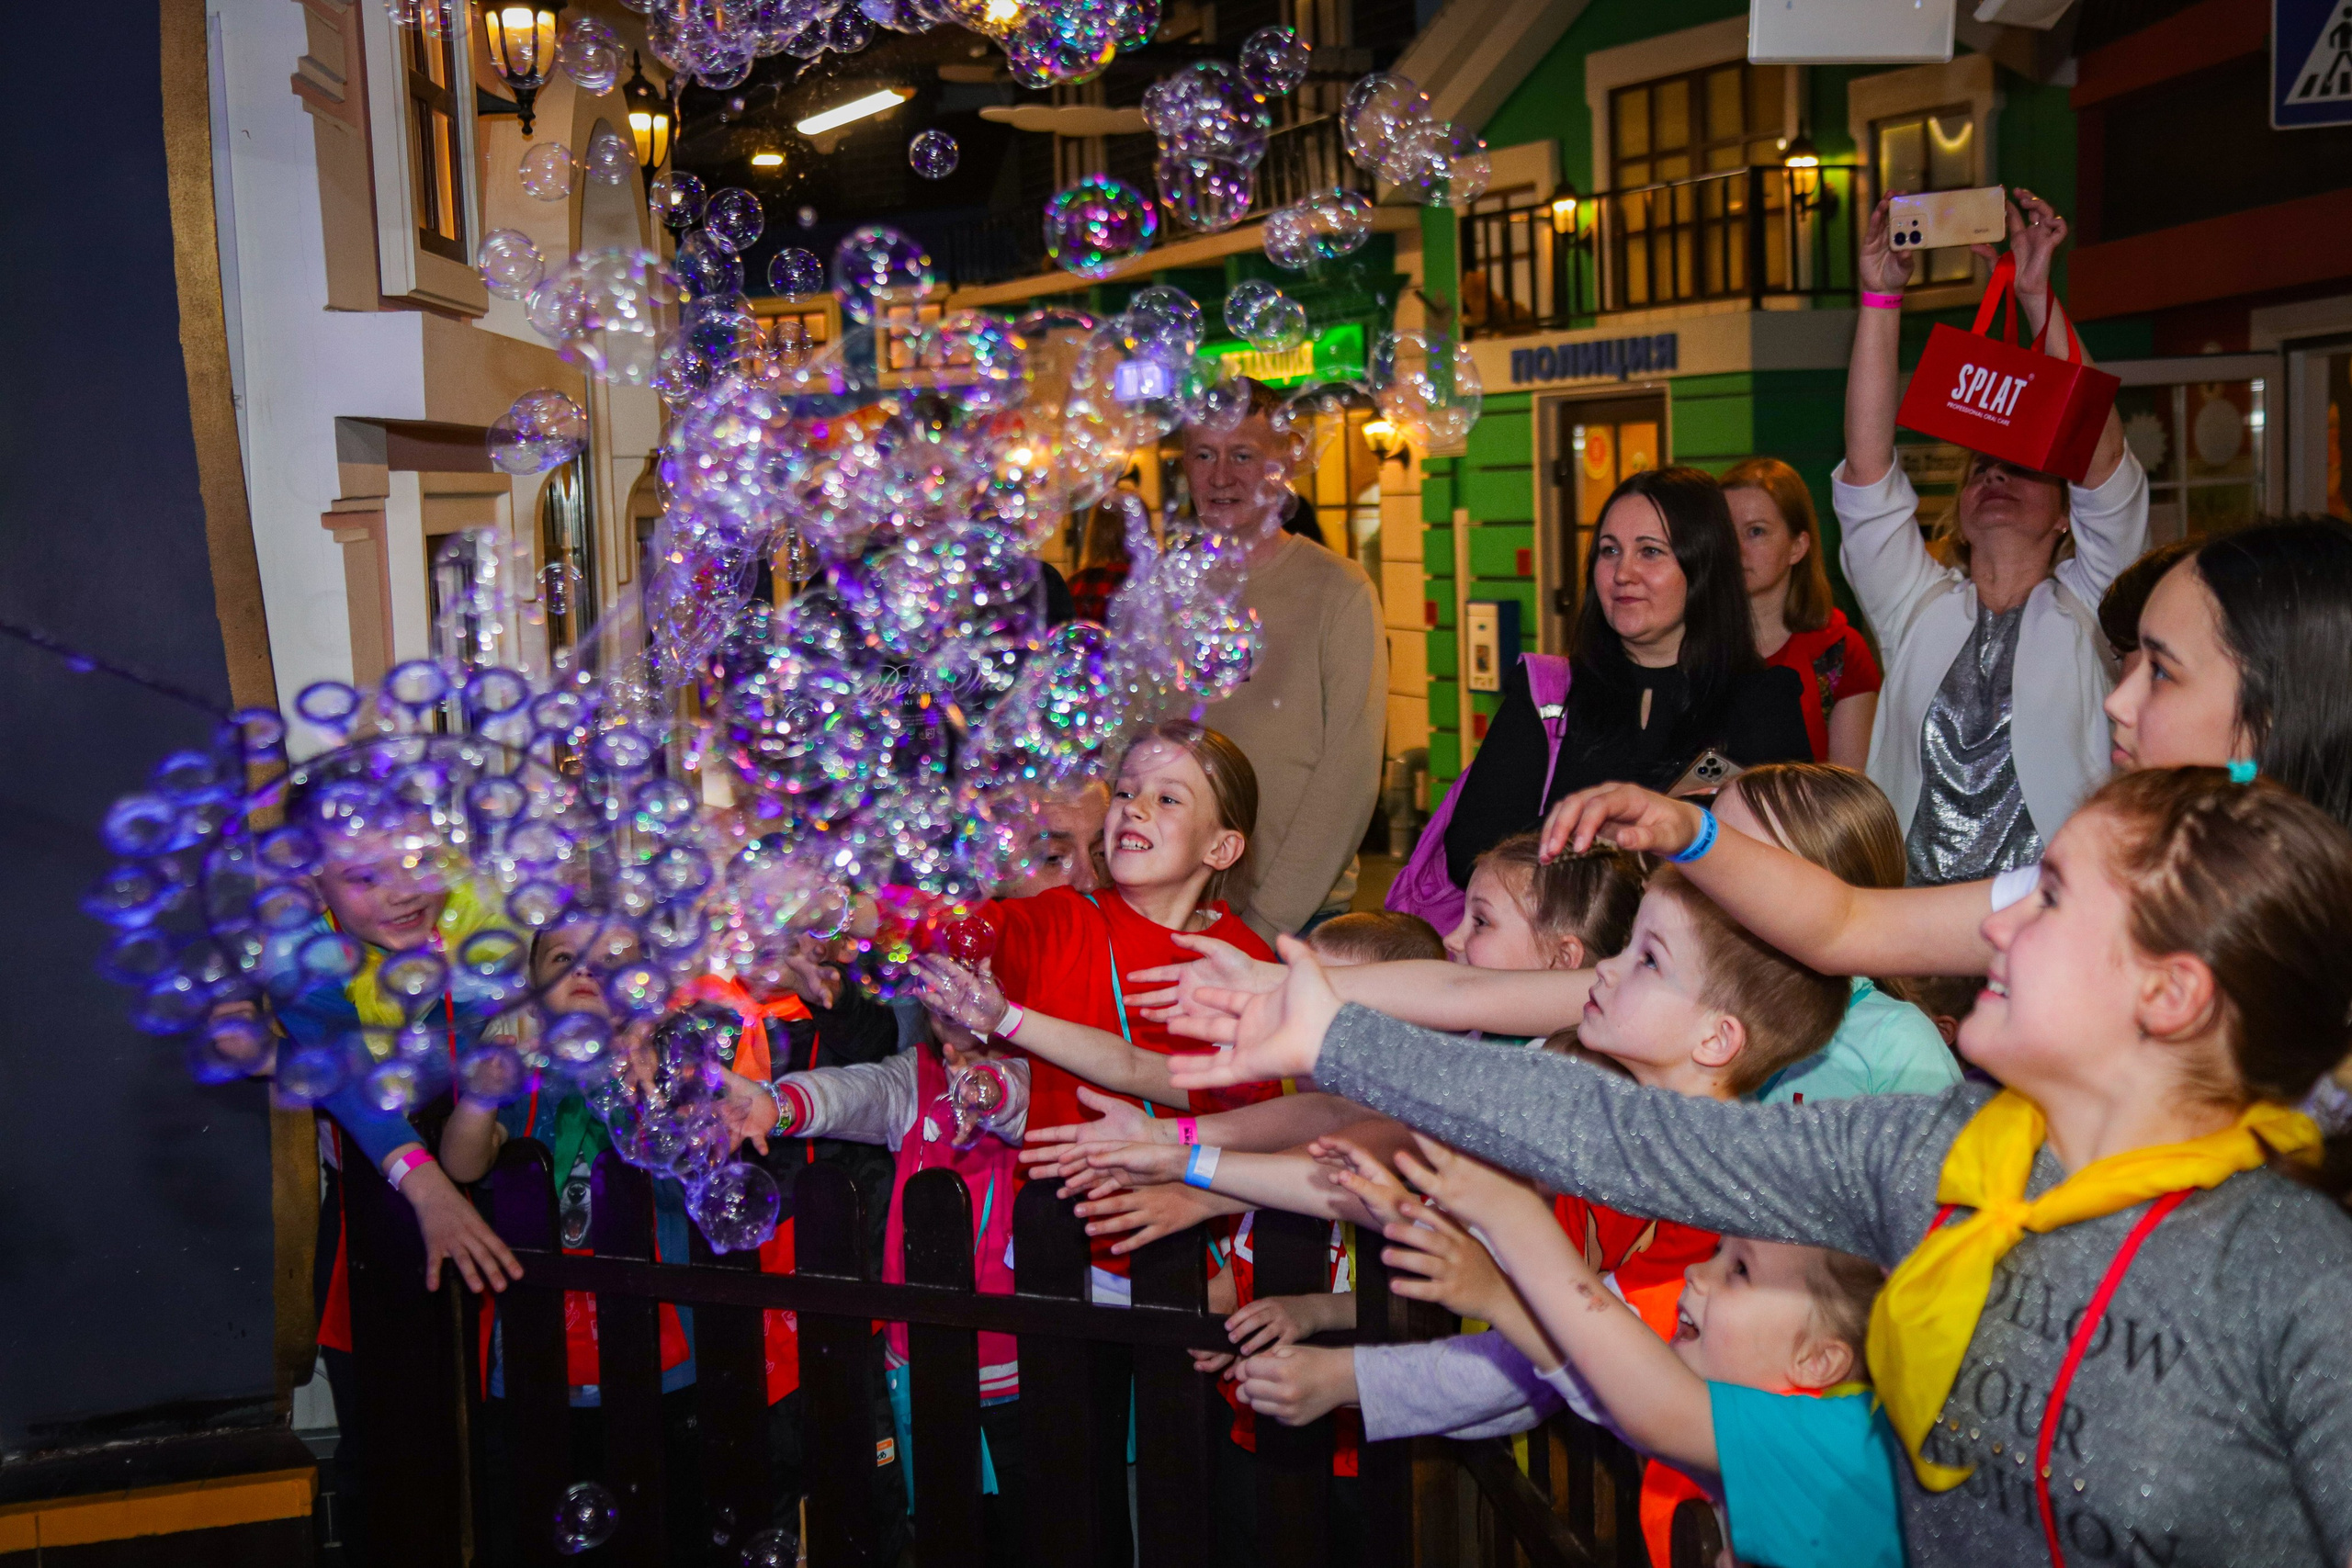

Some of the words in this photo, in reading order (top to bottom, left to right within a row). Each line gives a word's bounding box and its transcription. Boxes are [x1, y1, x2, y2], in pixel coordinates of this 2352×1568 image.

[1511, 333, 1678, 382] ПОЛИЦИЯ
[1946, 401, 1983, 418] PROFESSIONAL
[1951, 363, 2028, 416] SPLAT
